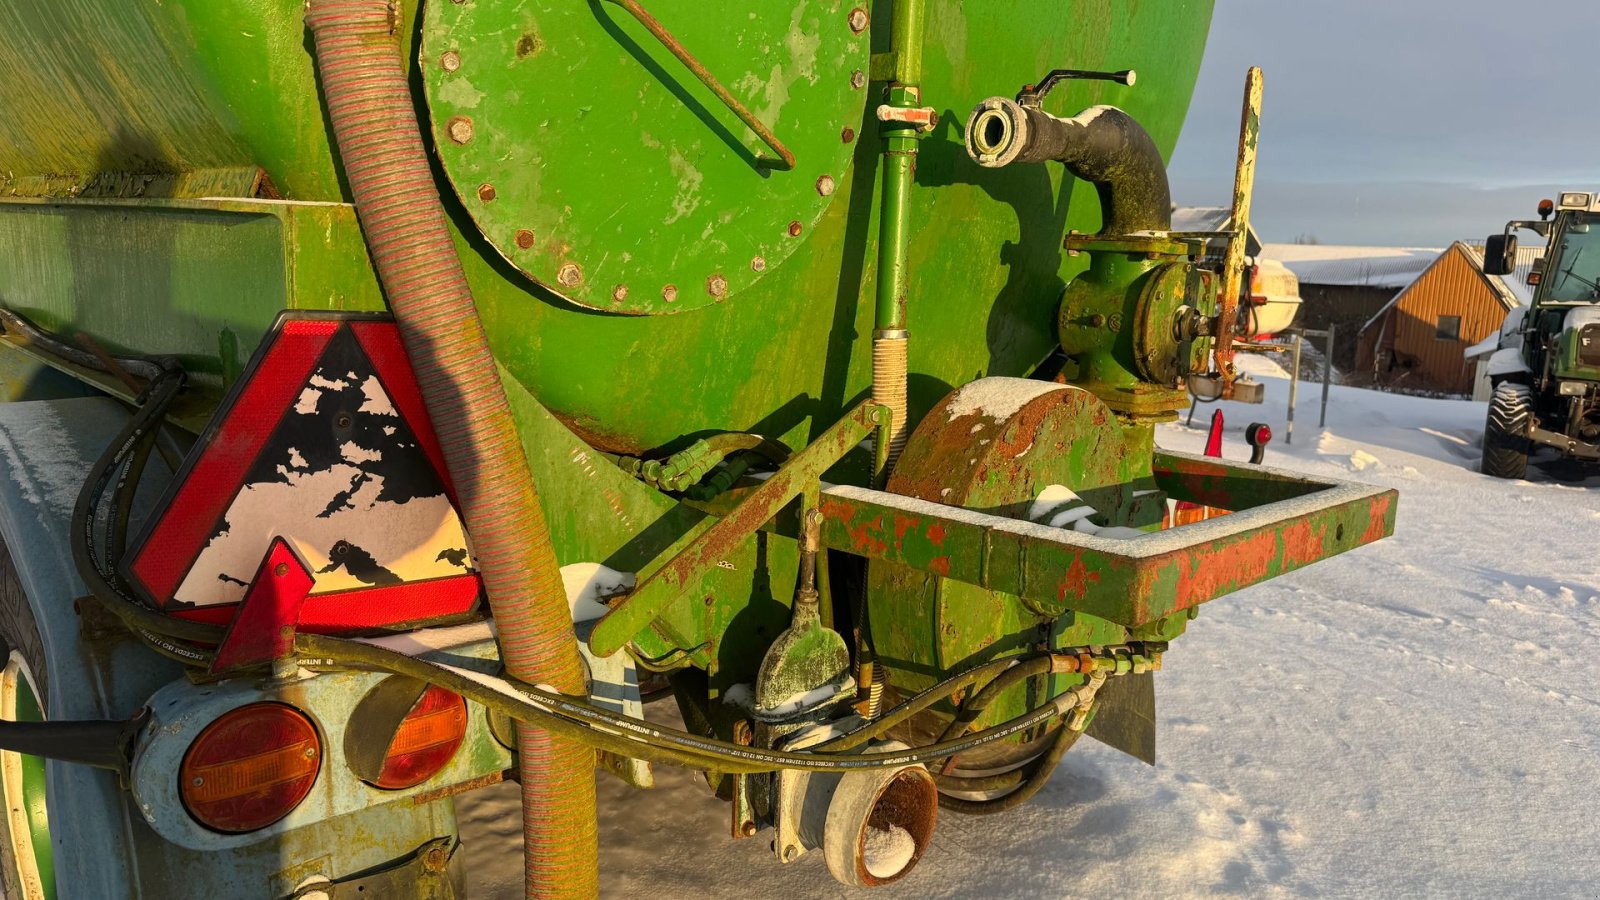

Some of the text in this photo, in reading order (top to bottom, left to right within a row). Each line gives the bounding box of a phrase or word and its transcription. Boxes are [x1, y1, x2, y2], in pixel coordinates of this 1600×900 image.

[174, 647, 204, 660] EXCEEDS
[530, 693, 555, 705] EXCEEDS
[616, 720, 650, 735] INTERPUMP
